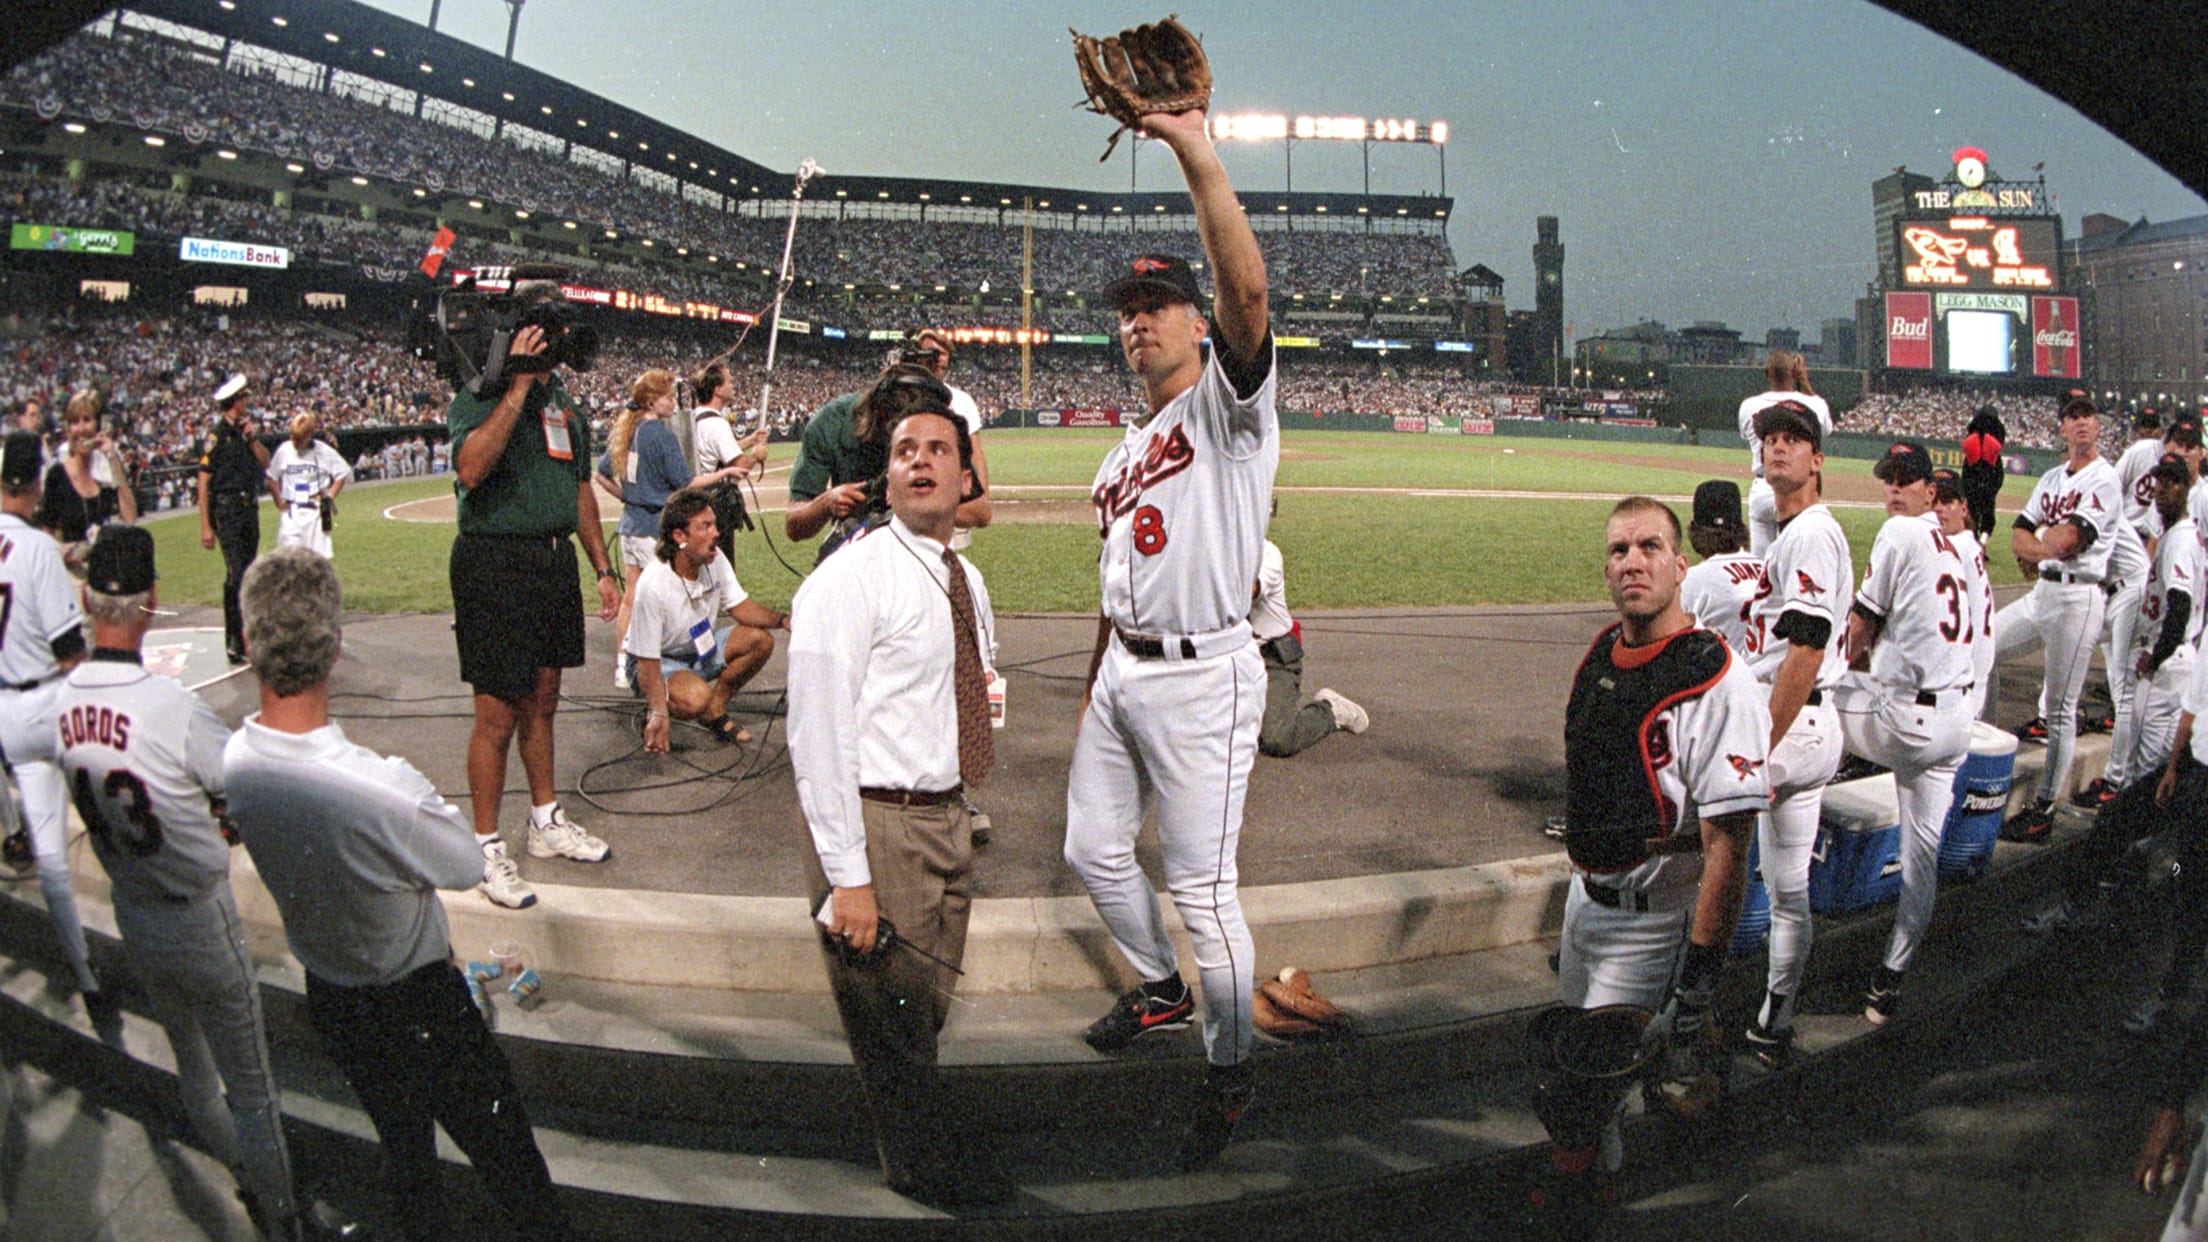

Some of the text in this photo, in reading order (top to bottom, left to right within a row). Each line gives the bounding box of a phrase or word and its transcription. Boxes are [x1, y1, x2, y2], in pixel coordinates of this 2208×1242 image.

[1915, 190, 2032, 208] THE SUN
[188, 241, 281, 265] NationsBank
[1939, 295, 2023, 308] LEGG MASON
[1891, 316, 1928, 336] Bud
[1069, 418, 1111, 426] Gasolines
[1075, 410, 1104, 419] Quality
[1133, 504, 1168, 556] 8
[1723, 561, 1763, 585] JONE
[1936, 572, 1974, 645] 37
[59, 704, 131, 752] BOROS
